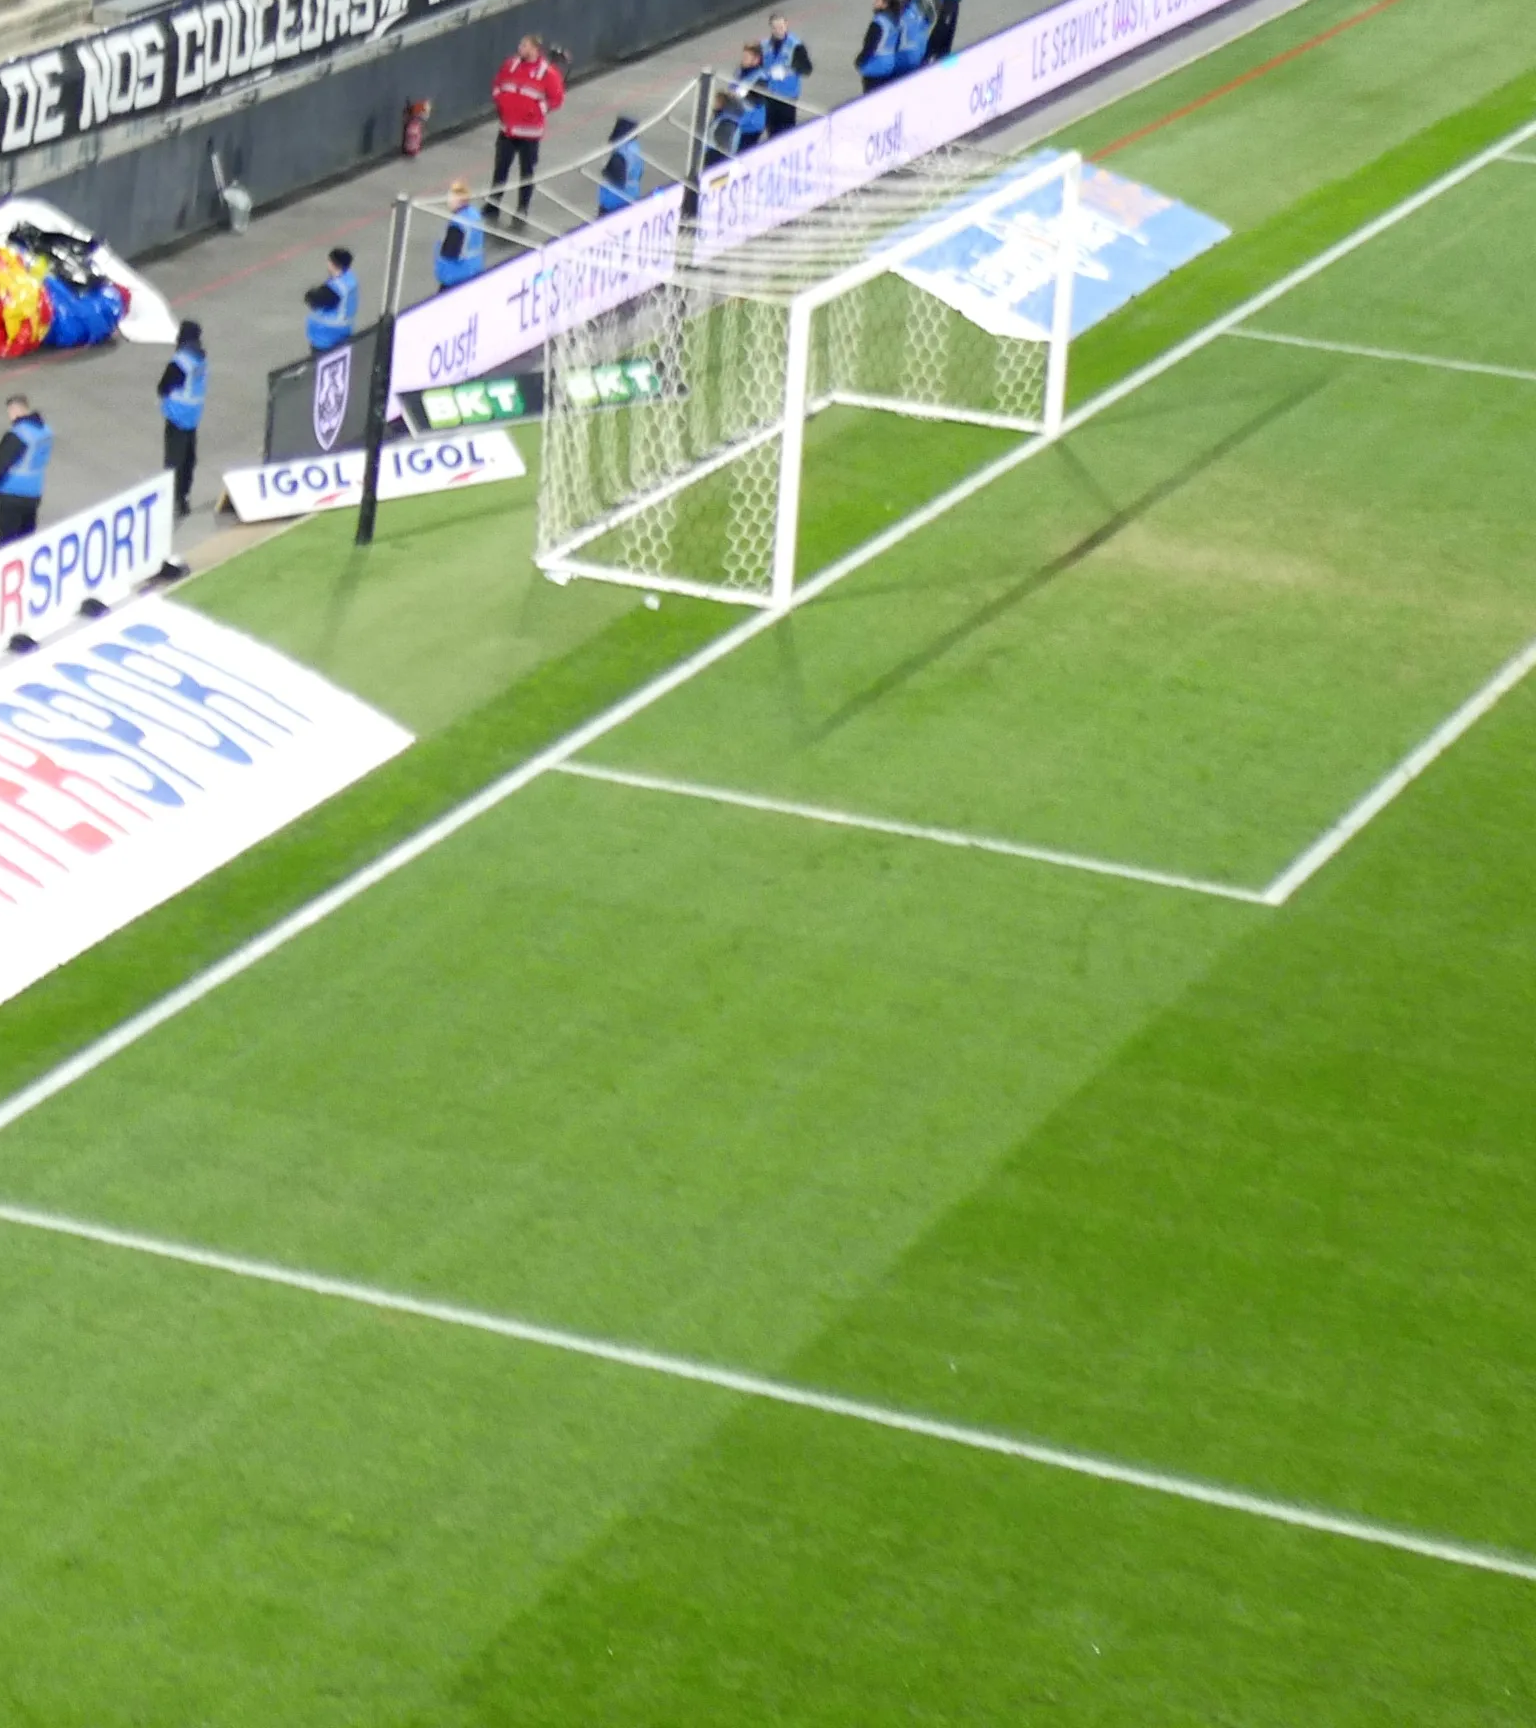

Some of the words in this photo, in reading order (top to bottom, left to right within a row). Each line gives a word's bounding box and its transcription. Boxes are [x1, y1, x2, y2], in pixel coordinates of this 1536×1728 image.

[1031, 34, 1049, 81] LE
[1051, 3, 1109, 68] SERVICE
[0, 52, 65, 153] DE
[77, 20, 166, 132] NOS
[426, 379, 518, 424] BKT
[566, 359, 656, 403] BKT
[258, 460, 350, 499] IGOL
[393, 440, 486, 479] IGOL
